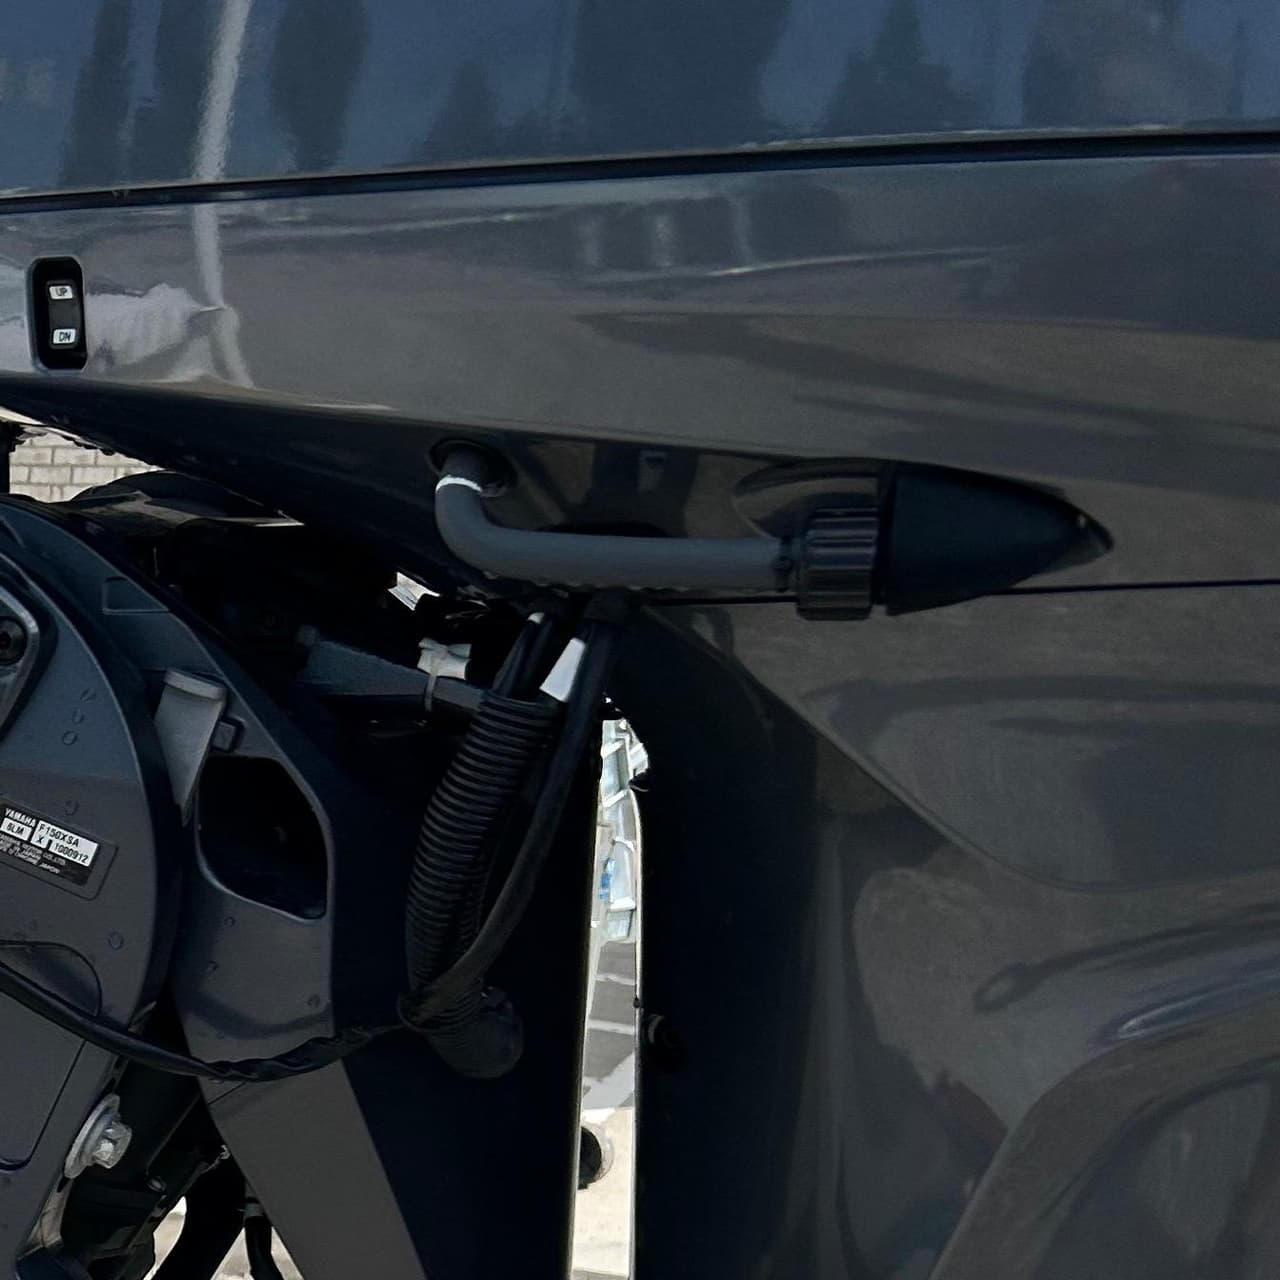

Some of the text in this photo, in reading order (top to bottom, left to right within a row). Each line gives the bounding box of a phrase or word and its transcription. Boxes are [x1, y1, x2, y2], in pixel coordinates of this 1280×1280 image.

[55, 287, 68, 297] UP
[5, 808, 36, 827] YAMAHA
[39, 823, 79, 847] F150XSA
